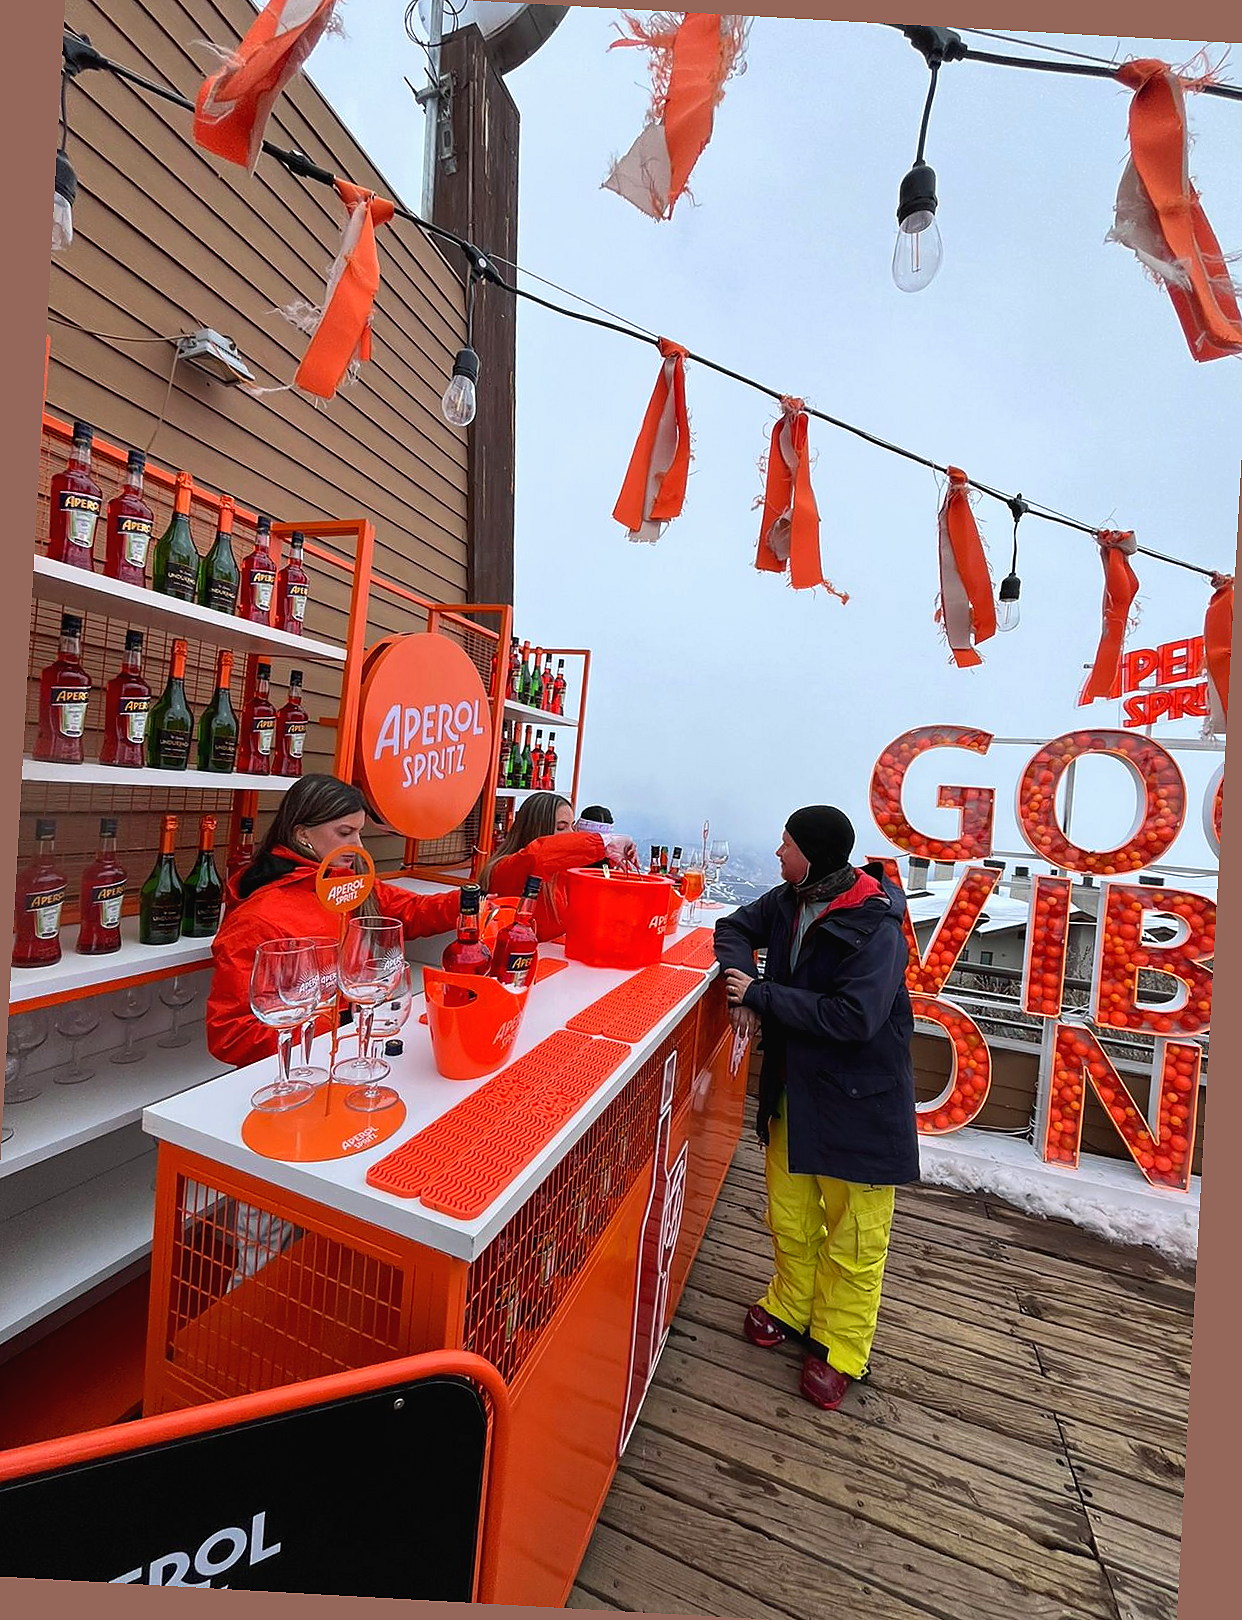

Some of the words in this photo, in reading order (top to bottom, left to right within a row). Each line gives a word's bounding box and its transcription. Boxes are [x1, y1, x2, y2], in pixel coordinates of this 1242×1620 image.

[373, 699, 484, 761] APEROL
[402, 743, 466, 789] SPRITZ
[868, 724, 1224, 877] GO
[327, 878, 365, 901] APEROL
[335, 891, 358, 906] SPRITZ
[342, 1125, 380, 1151] APEROL
[108, 1511, 281, 1590] ROL
